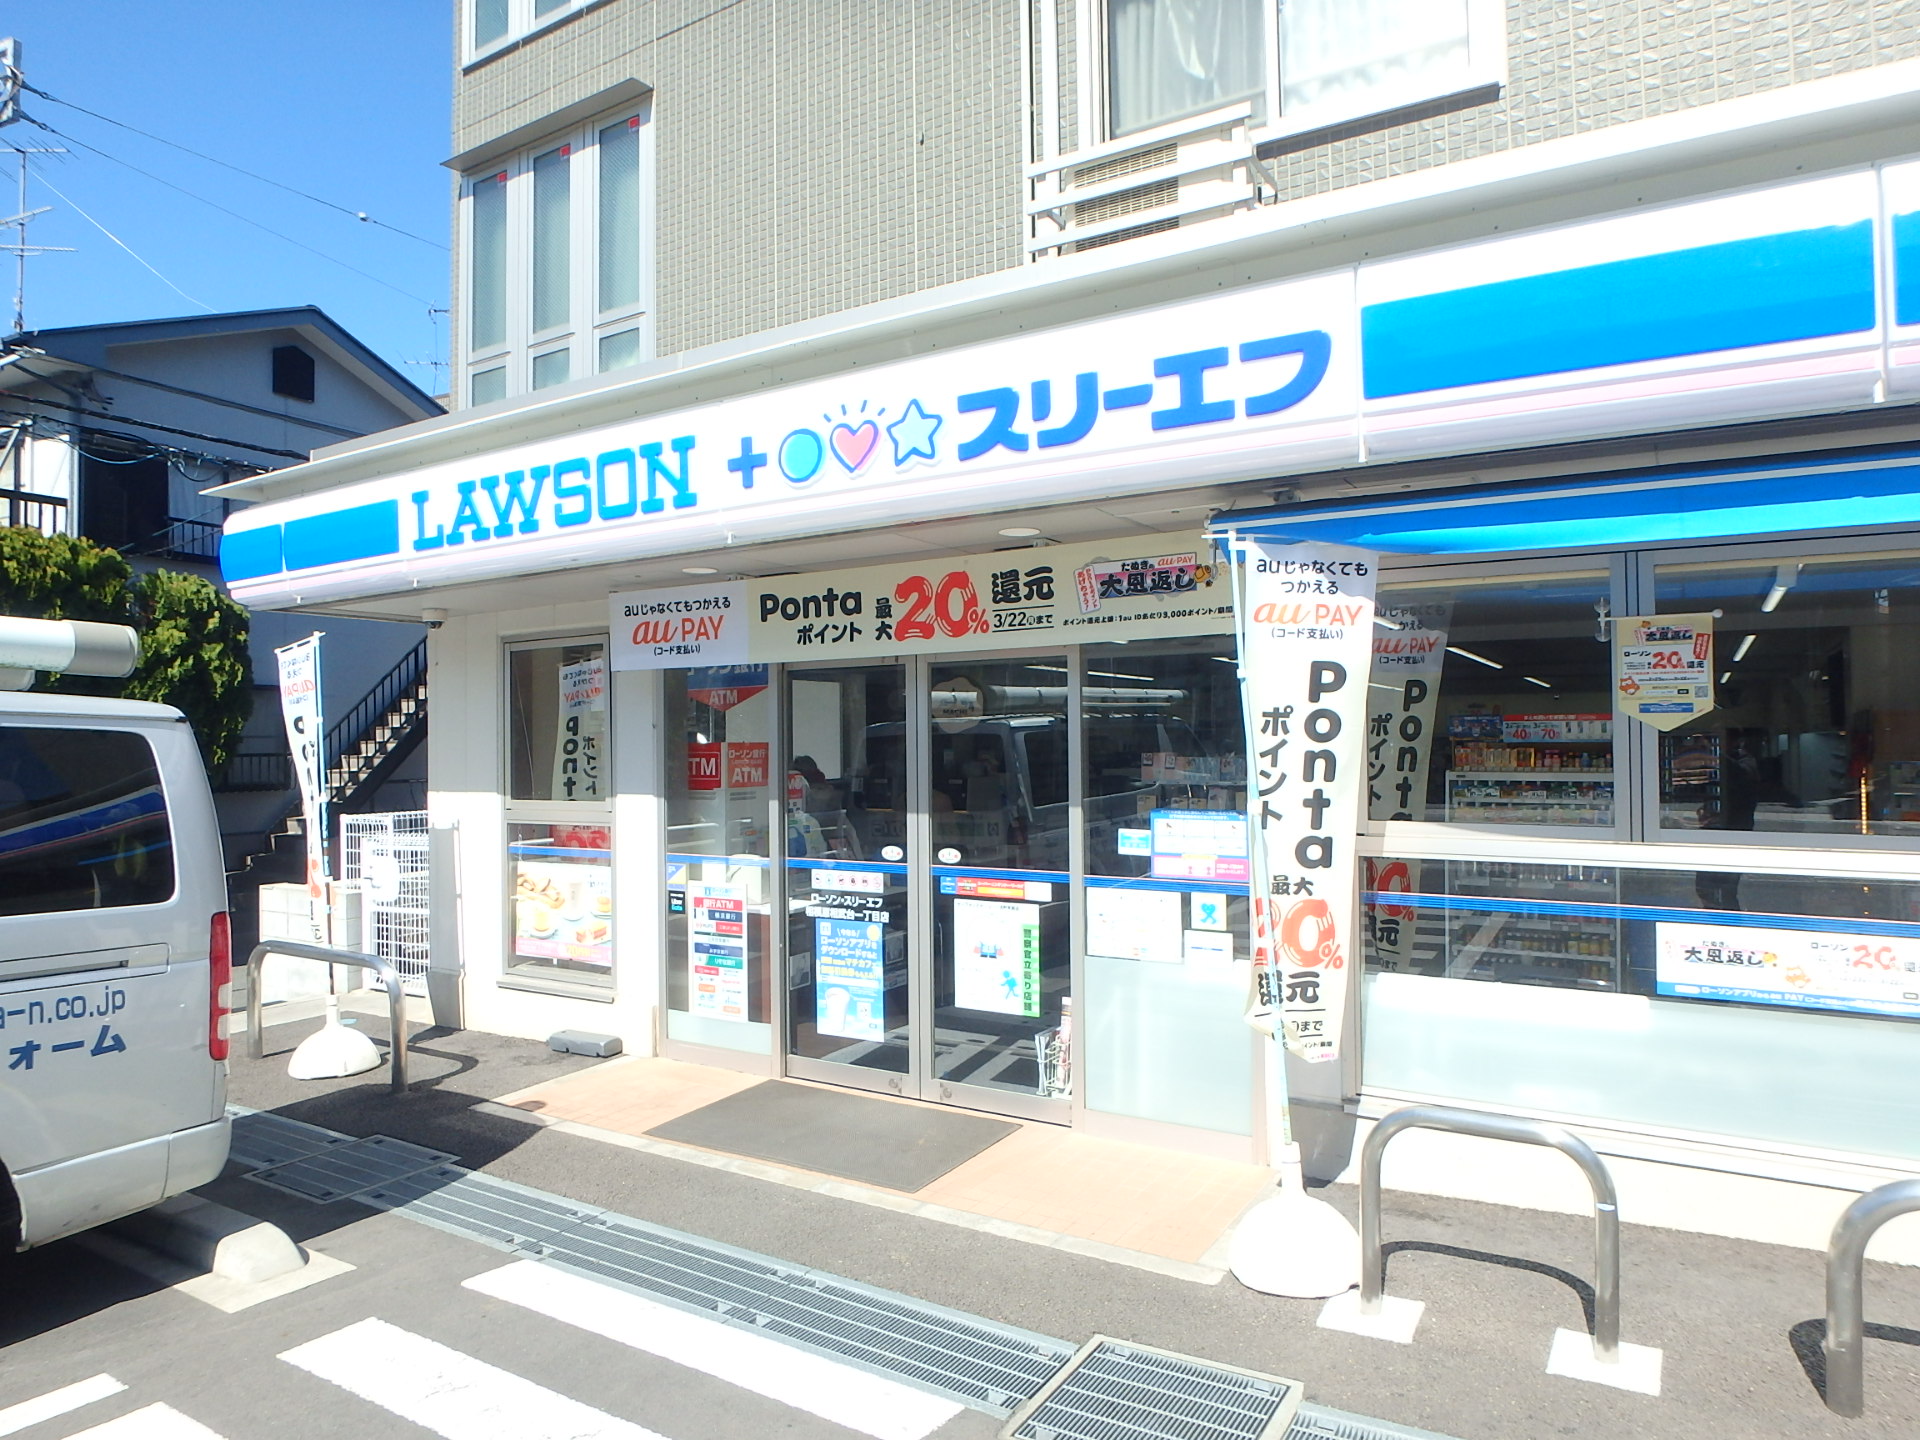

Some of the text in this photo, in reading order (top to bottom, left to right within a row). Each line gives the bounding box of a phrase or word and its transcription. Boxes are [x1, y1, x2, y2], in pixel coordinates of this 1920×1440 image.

[412, 435, 697, 552] LAWSON
[957, 329, 1332, 461] スリーエフ
[1176, 554, 1194, 565] PAY
[1256, 557, 1369, 577] auじゃなくても
[1100, 567, 1195, 597] 大恩返し
[1280, 579, 1340, 596] つかえる
[624, 596, 732, 618] auじゃなくてもつかえる
[759, 587, 862, 622] Ponta
[875, 597, 894, 642] 最大
[894, 570, 991, 642] 20%
[991, 565, 1055, 604] 還元
[1253, 602, 1364, 627] au PAY
[632, 614, 726, 646] au PAY
[796, 620, 864, 646] ポイント
[1271, 628, 1344, 641] (コード支払い)
[1409, 635, 1440, 655] PAY
[1623, 650, 1651, 658] ローソン
[708, 689, 738, 705] ATM
[687, 757, 716, 776] TM
[732, 767, 763, 784] ATM
[1257, 704, 1294, 830] ポイント
[1294, 660, 1348, 869] Ponta
[1270, 874, 1315, 897] 最大
[1810, 941, 1849, 952] ローソン
